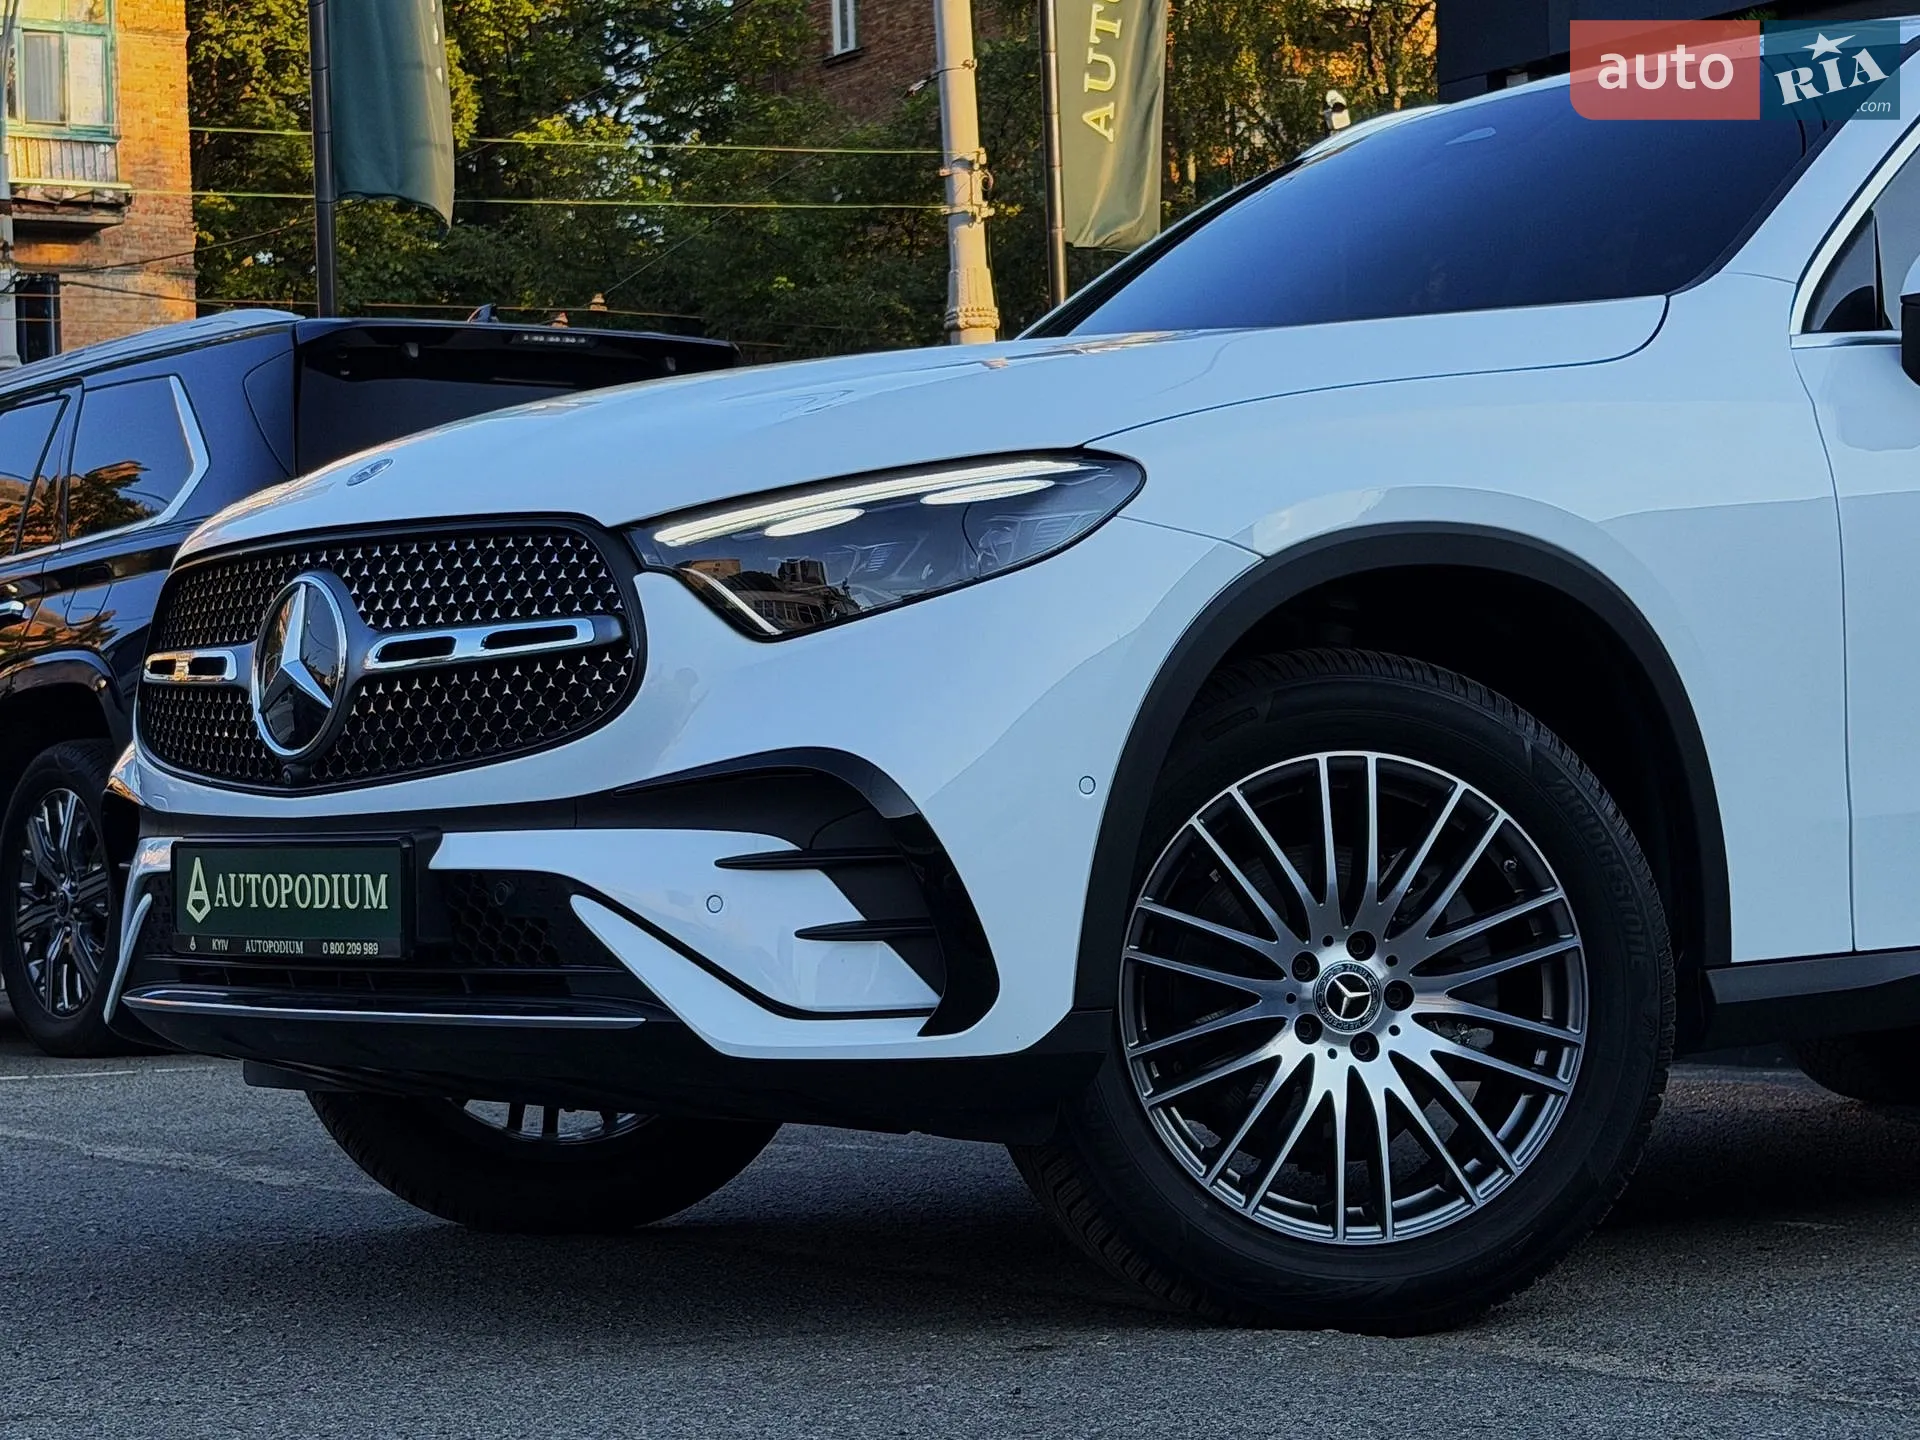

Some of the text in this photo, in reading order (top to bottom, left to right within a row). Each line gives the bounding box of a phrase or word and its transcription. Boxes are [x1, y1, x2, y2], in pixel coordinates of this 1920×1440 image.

[1082, 0, 1122, 143] AUT
[214, 873, 389, 910] AUTOPODIUM
[211, 938, 379, 956] KYIV AUTOPODIUM 0 800 209 989
